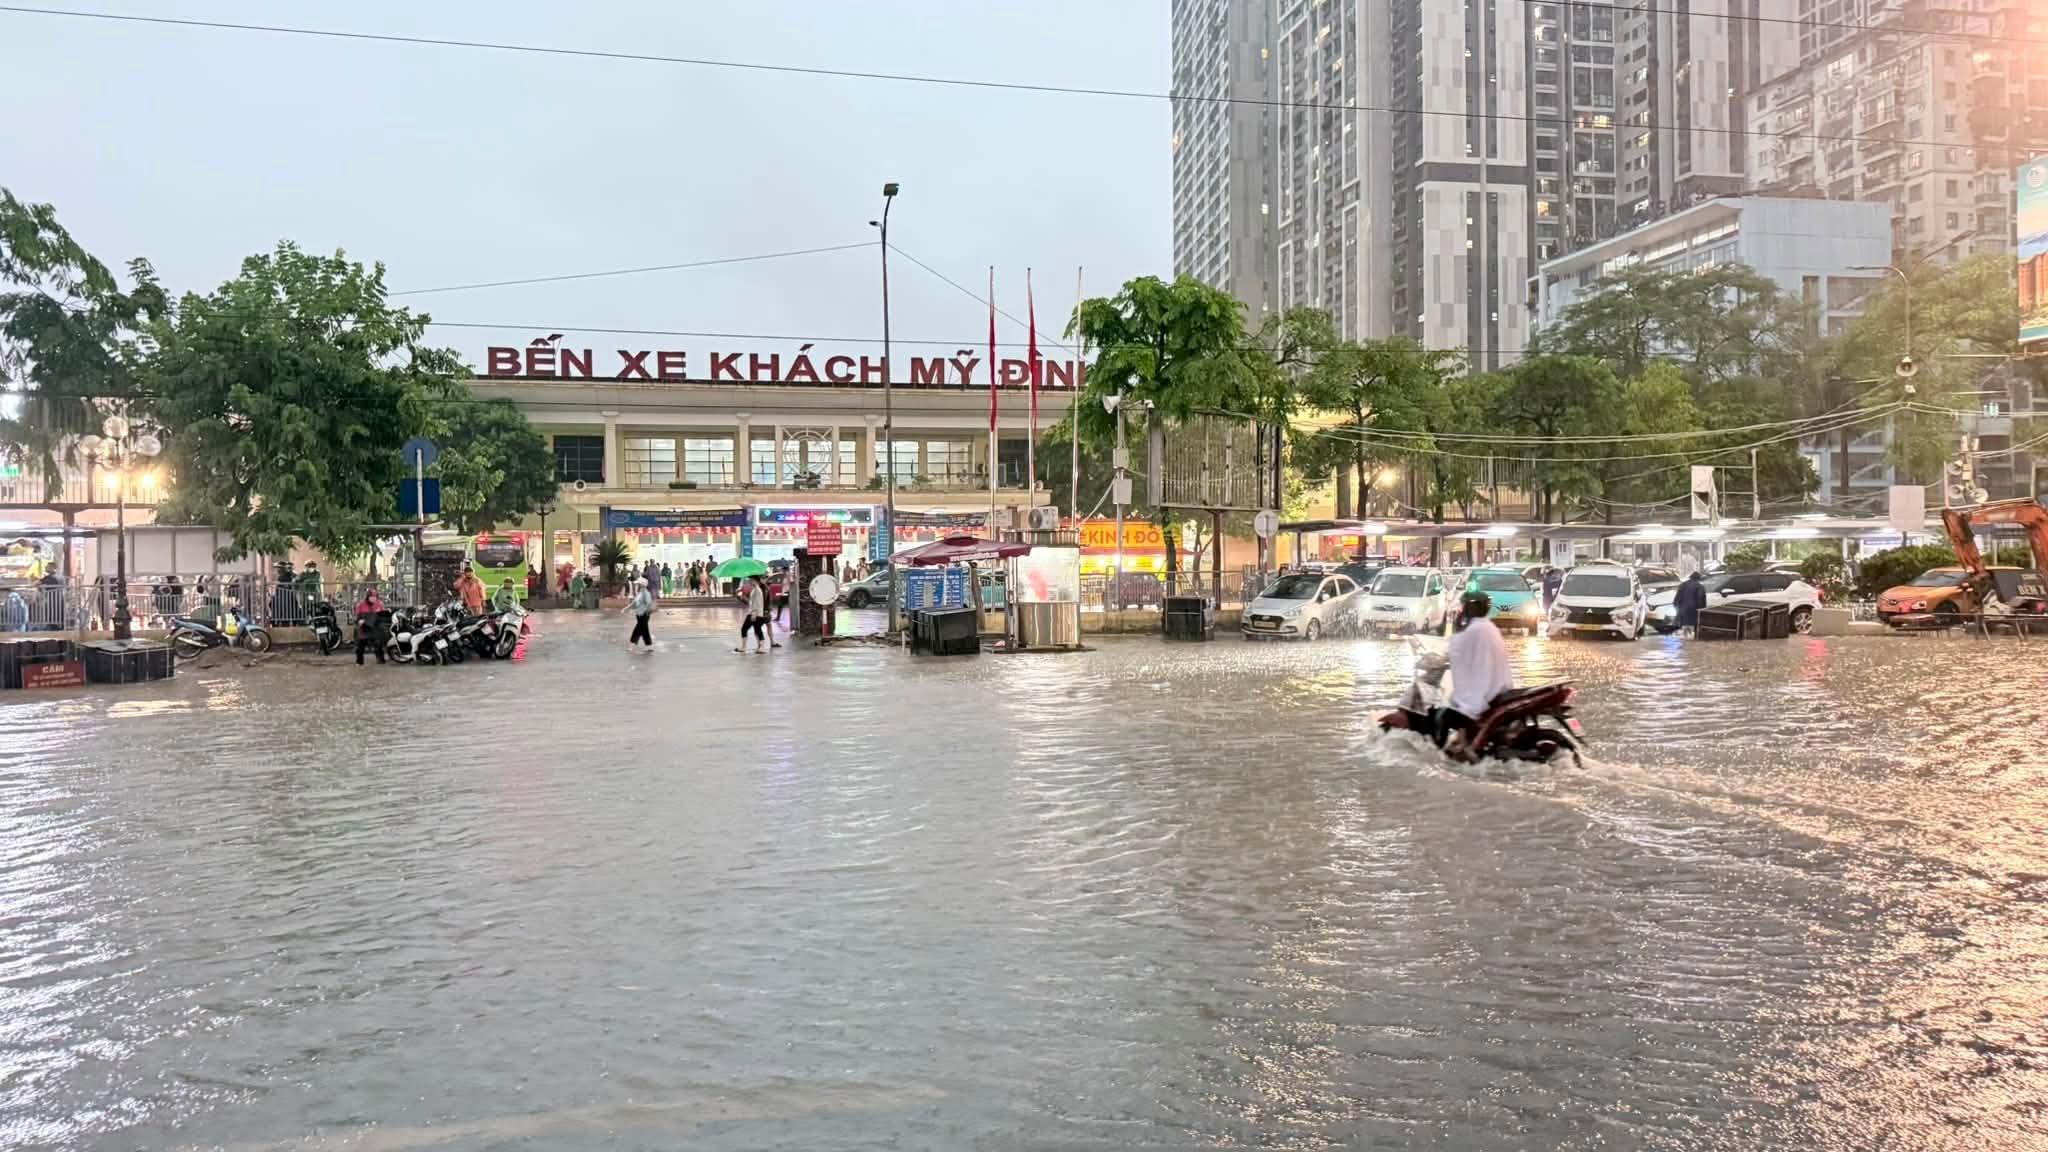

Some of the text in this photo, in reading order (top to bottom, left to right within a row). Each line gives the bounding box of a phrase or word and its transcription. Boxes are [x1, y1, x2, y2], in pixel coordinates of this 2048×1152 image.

[487, 334, 593, 377] BẾN
[616, 350, 687, 378] XE
[709, 344, 886, 383] KHÁCH
[910, 349, 981, 385] MỸ
